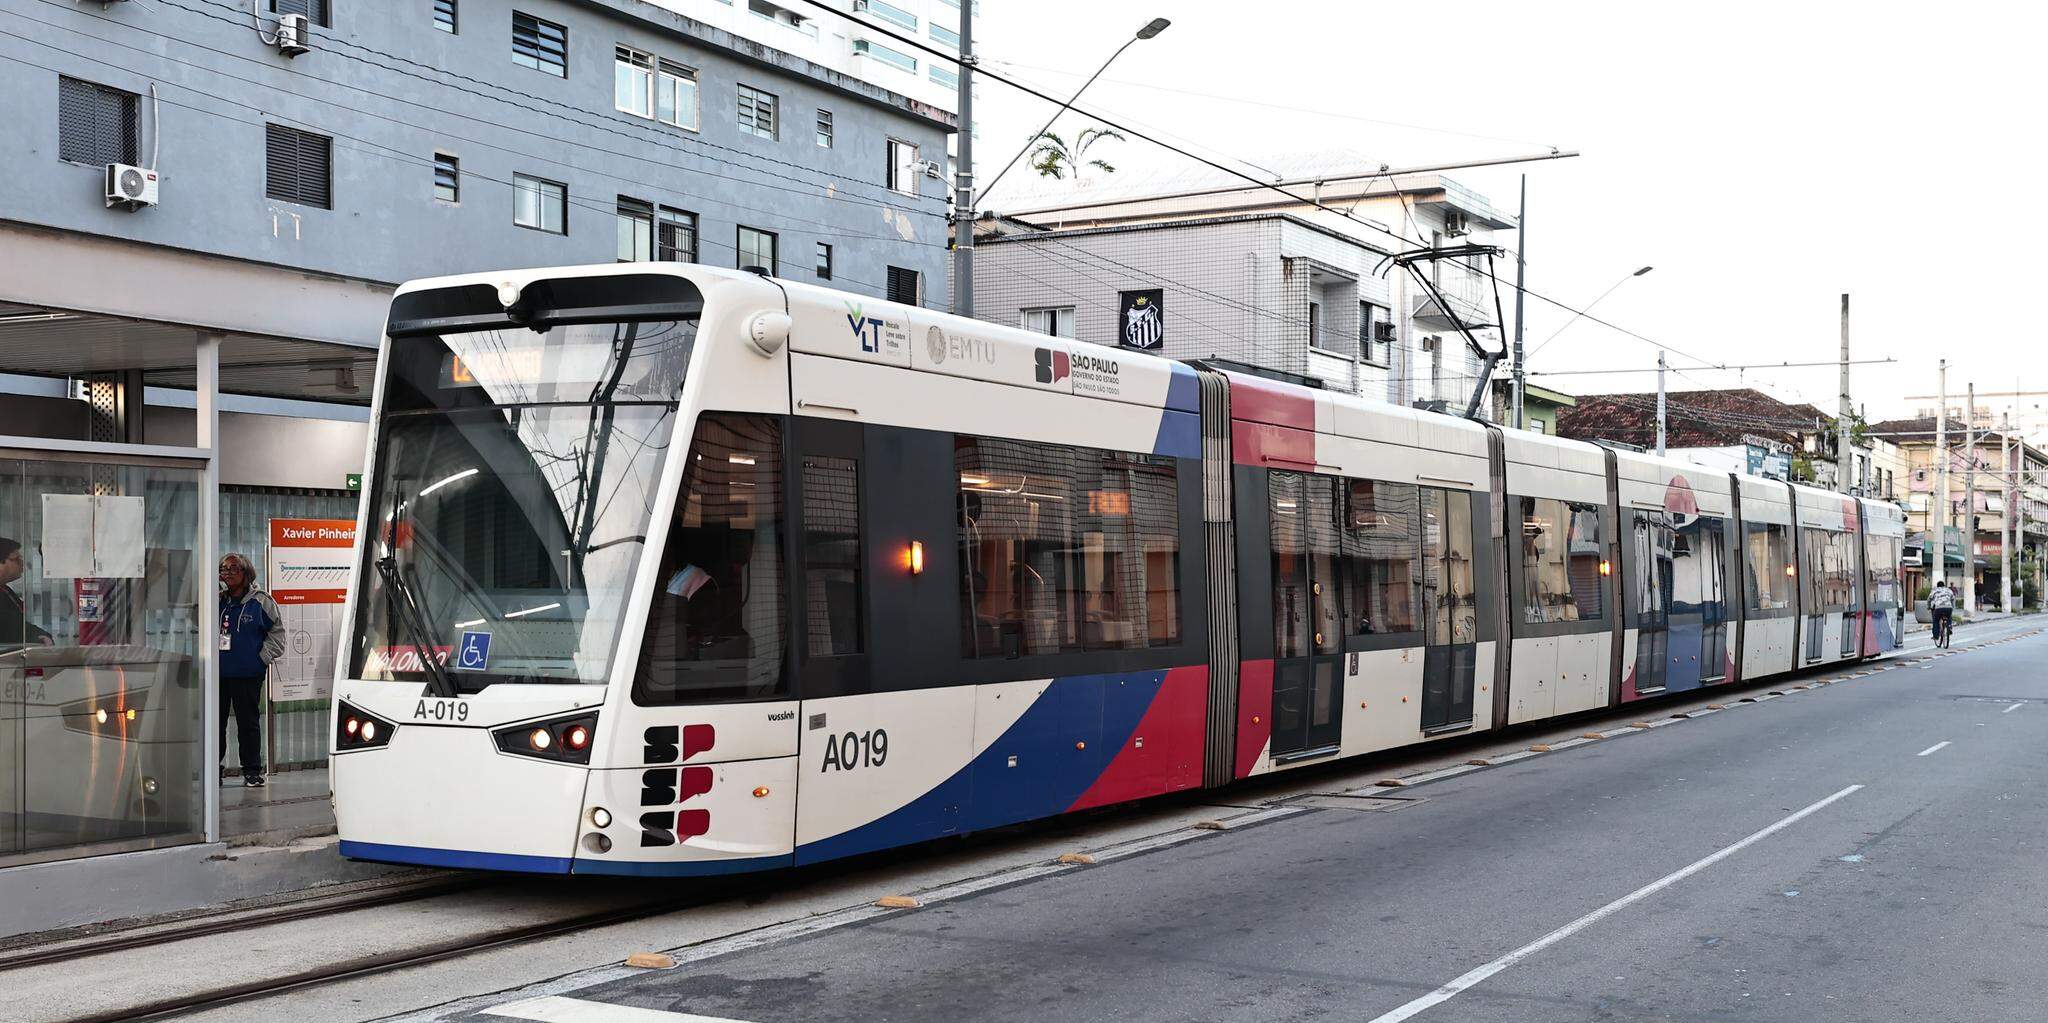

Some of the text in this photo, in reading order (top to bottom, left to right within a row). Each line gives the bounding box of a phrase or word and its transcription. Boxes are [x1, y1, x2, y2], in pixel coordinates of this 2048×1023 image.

[847, 313, 883, 353] VLT
[949, 335, 996, 364] EMTU
[1071, 350, 1119, 375] SÃO PAULO
[1072, 371, 1119, 385] GOVERNO DO ESTADO
[282, 527, 316, 539] Xavier
[413, 699, 469, 721] A-019
[821, 728, 888, 773] A019
